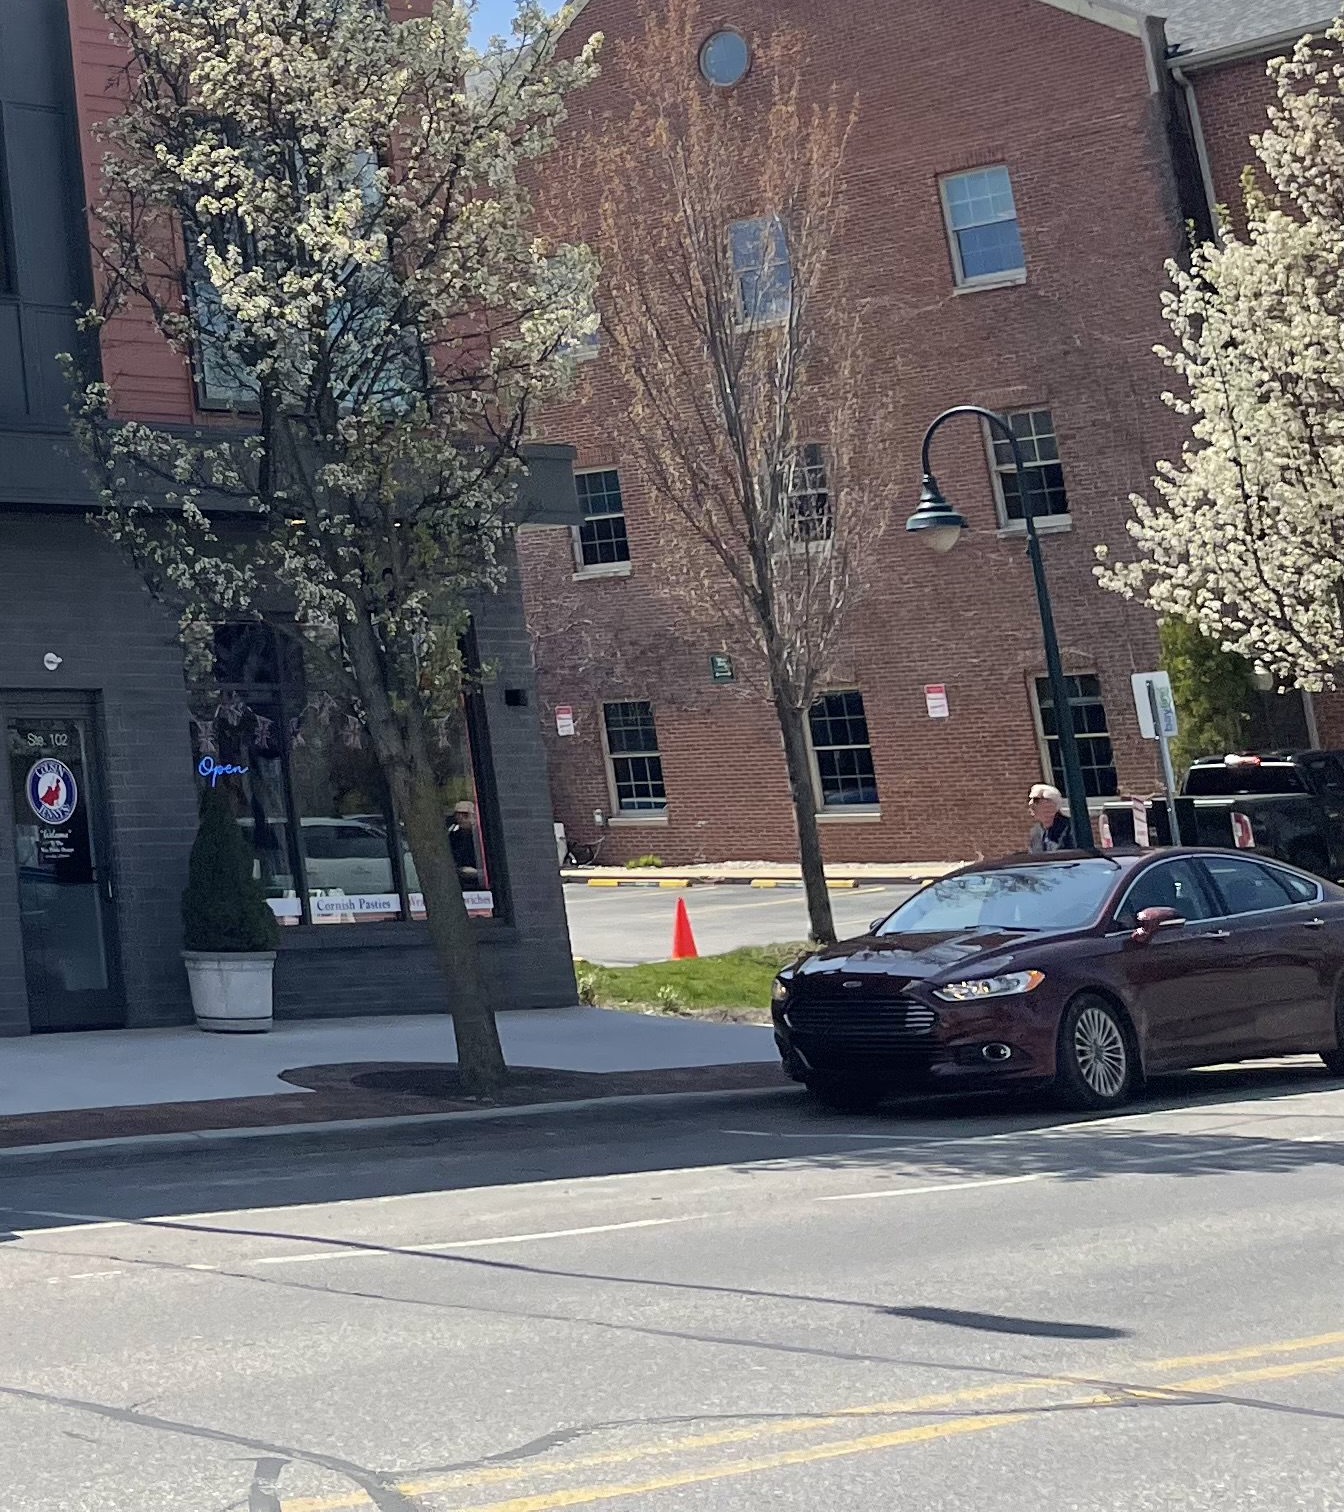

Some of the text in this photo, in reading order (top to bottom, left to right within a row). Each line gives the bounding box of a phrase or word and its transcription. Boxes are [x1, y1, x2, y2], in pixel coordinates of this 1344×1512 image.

[50, 734, 69, 747] 102
[198, 756, 249, 788] Open
[316, 898, 356, 912] Cornish
[358, 896, 391, 910] Pasties
